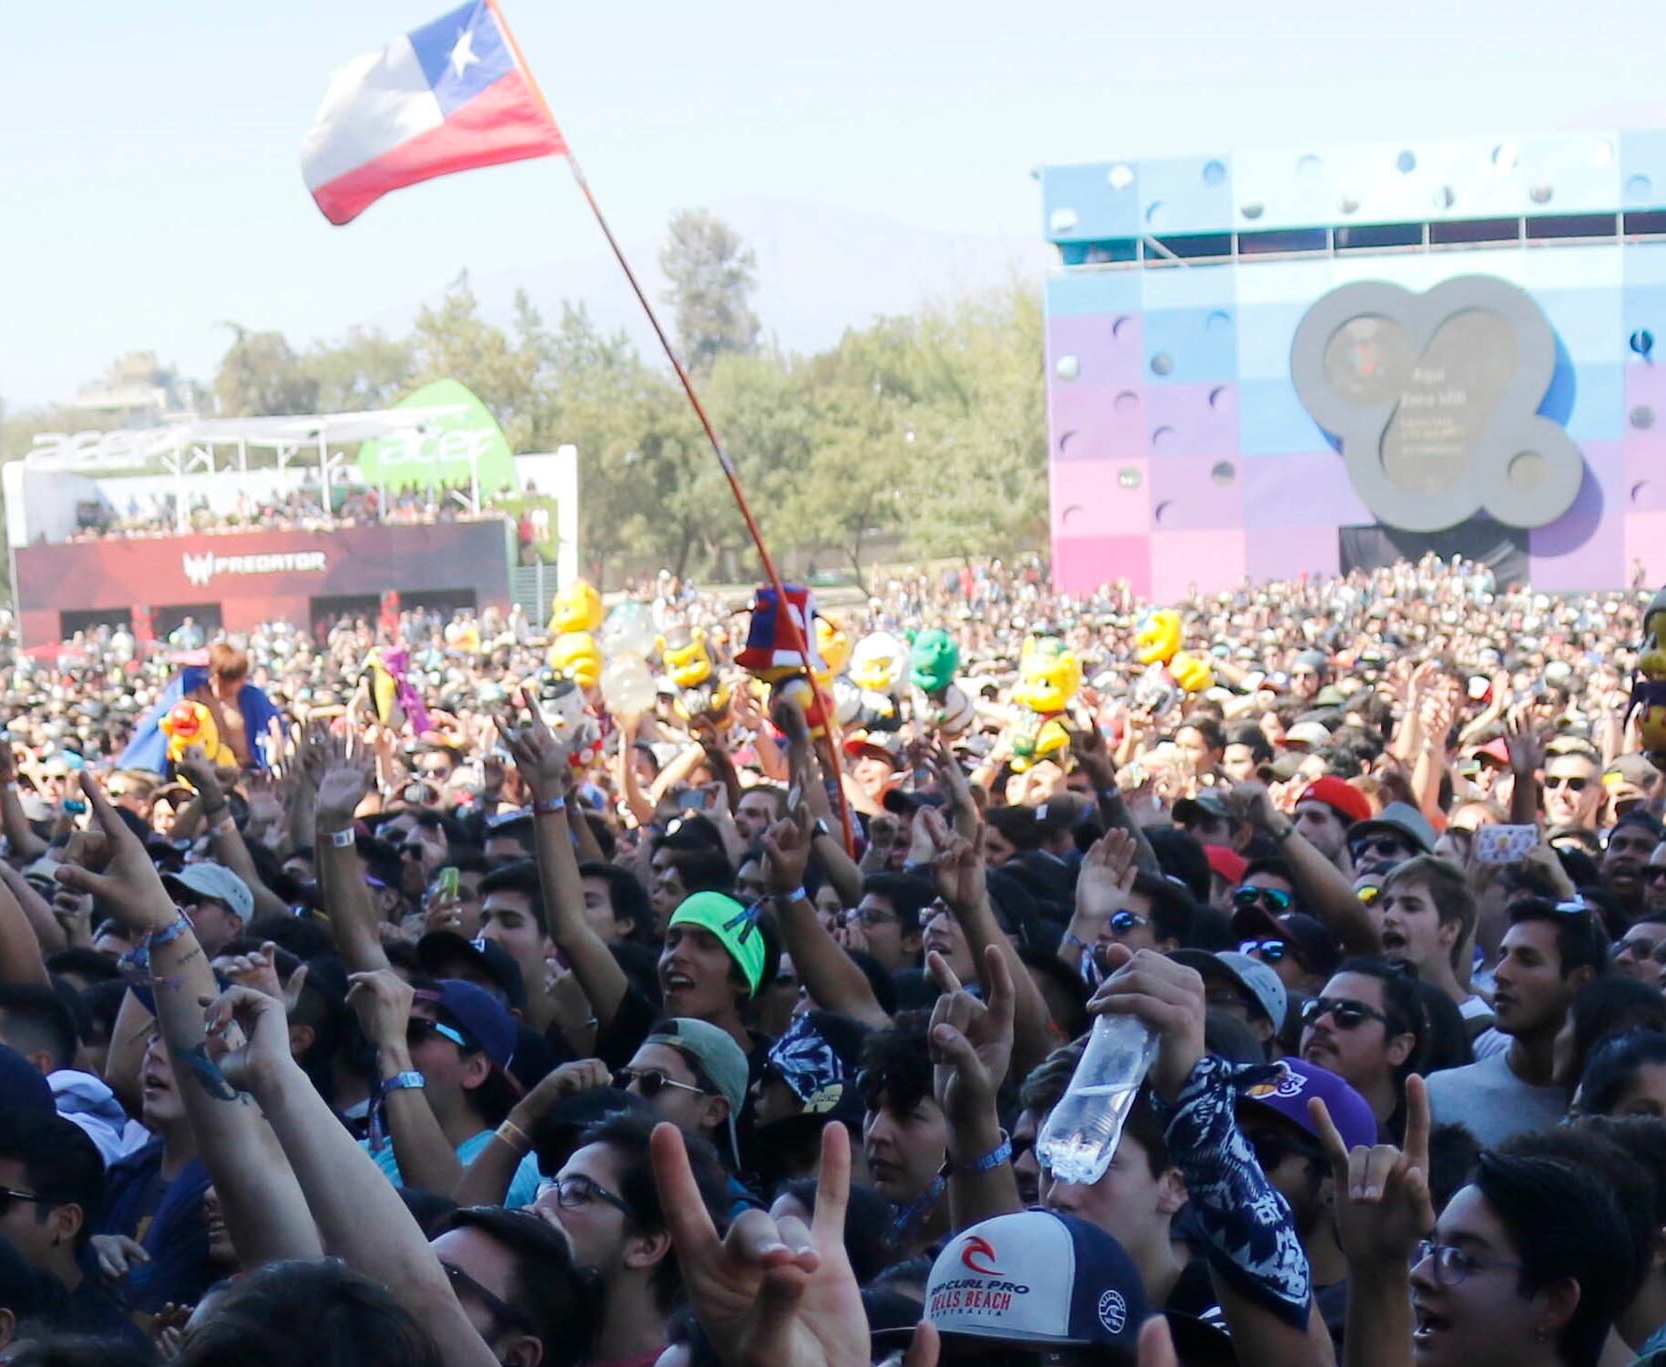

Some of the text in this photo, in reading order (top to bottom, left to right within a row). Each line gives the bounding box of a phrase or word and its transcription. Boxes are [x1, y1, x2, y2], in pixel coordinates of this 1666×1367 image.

[379, 427, 497, 463] acer
[214, 551, 327, 575] PREDATOR
[946, 1279, 983, 1290] CURL
[988, 1281, 1029, 1294] PRO
[965, 1291, 1011, 1310] BEACH
